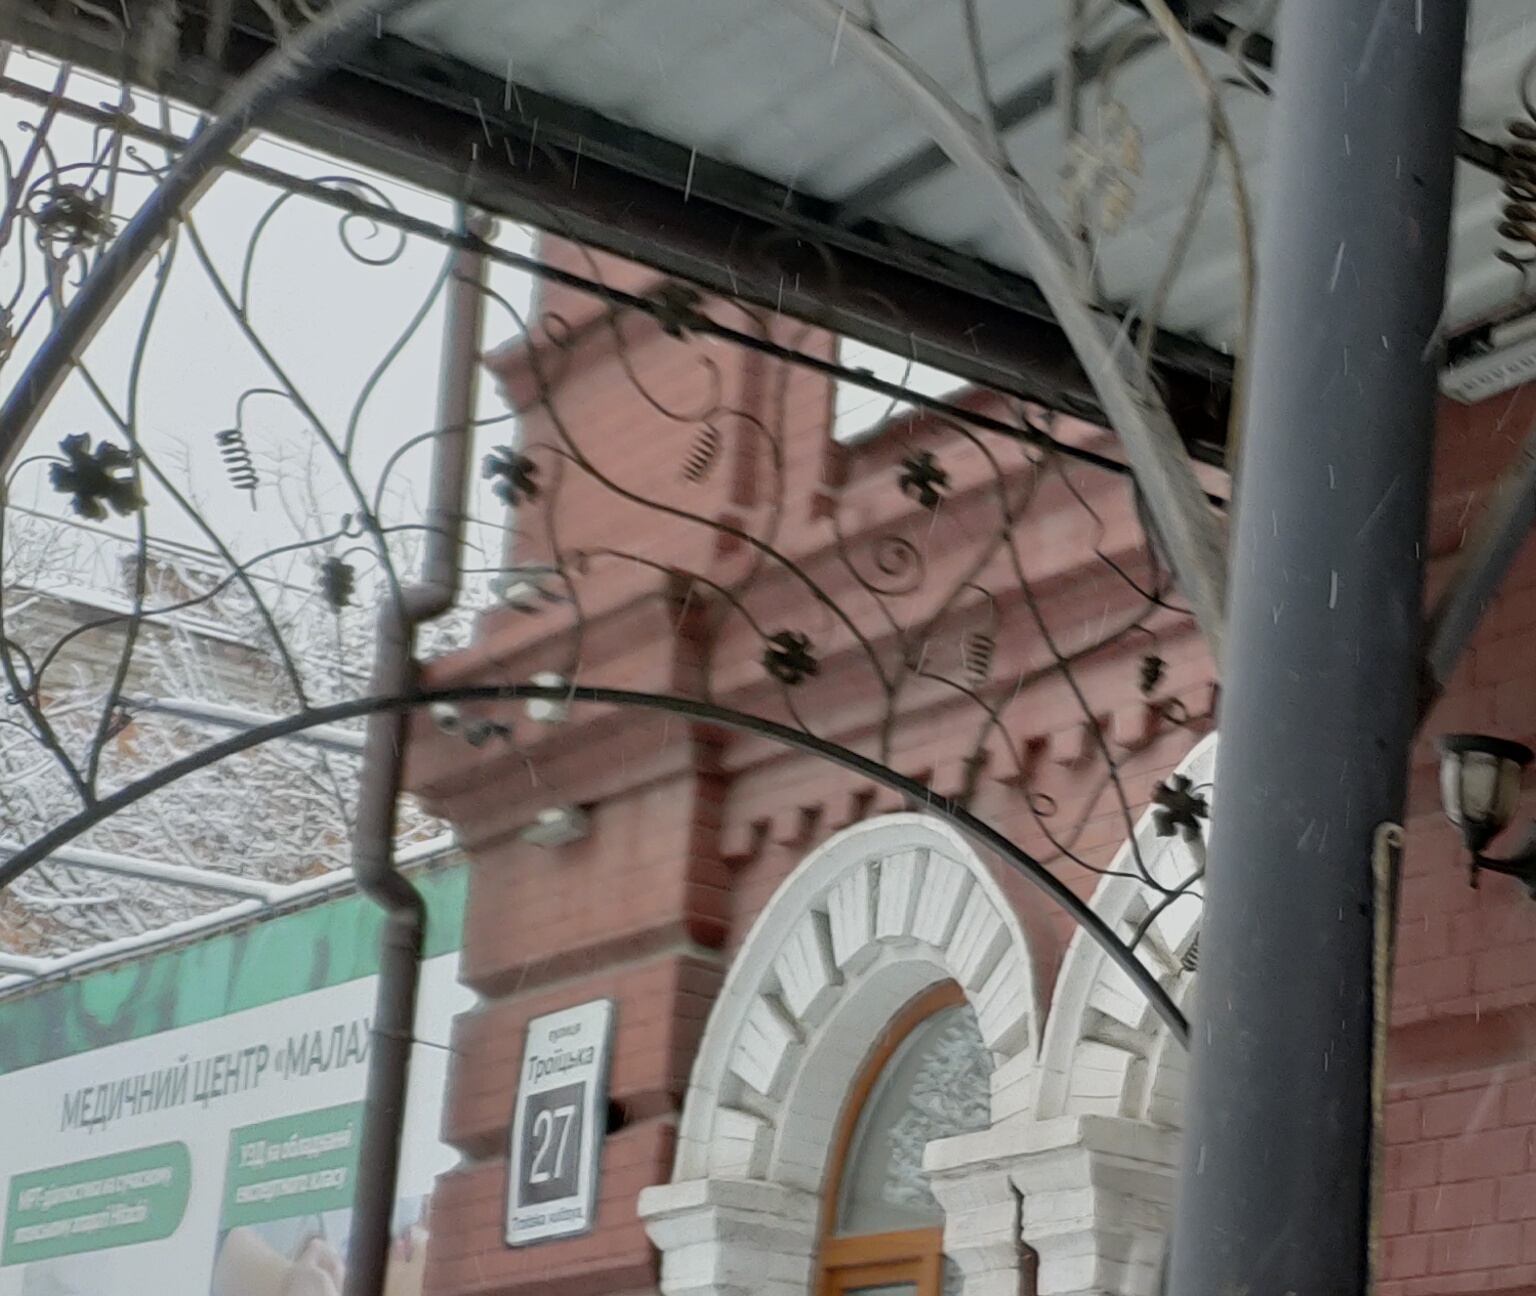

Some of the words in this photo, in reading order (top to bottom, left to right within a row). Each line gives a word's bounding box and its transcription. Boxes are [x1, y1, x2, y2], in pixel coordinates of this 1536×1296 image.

[60, 1055, 189, 1133] МЕДИЧНИЙ
[193, 1045, 269, 1109] ЦЕНТР
[529, 1105, 576, 1184] 27
